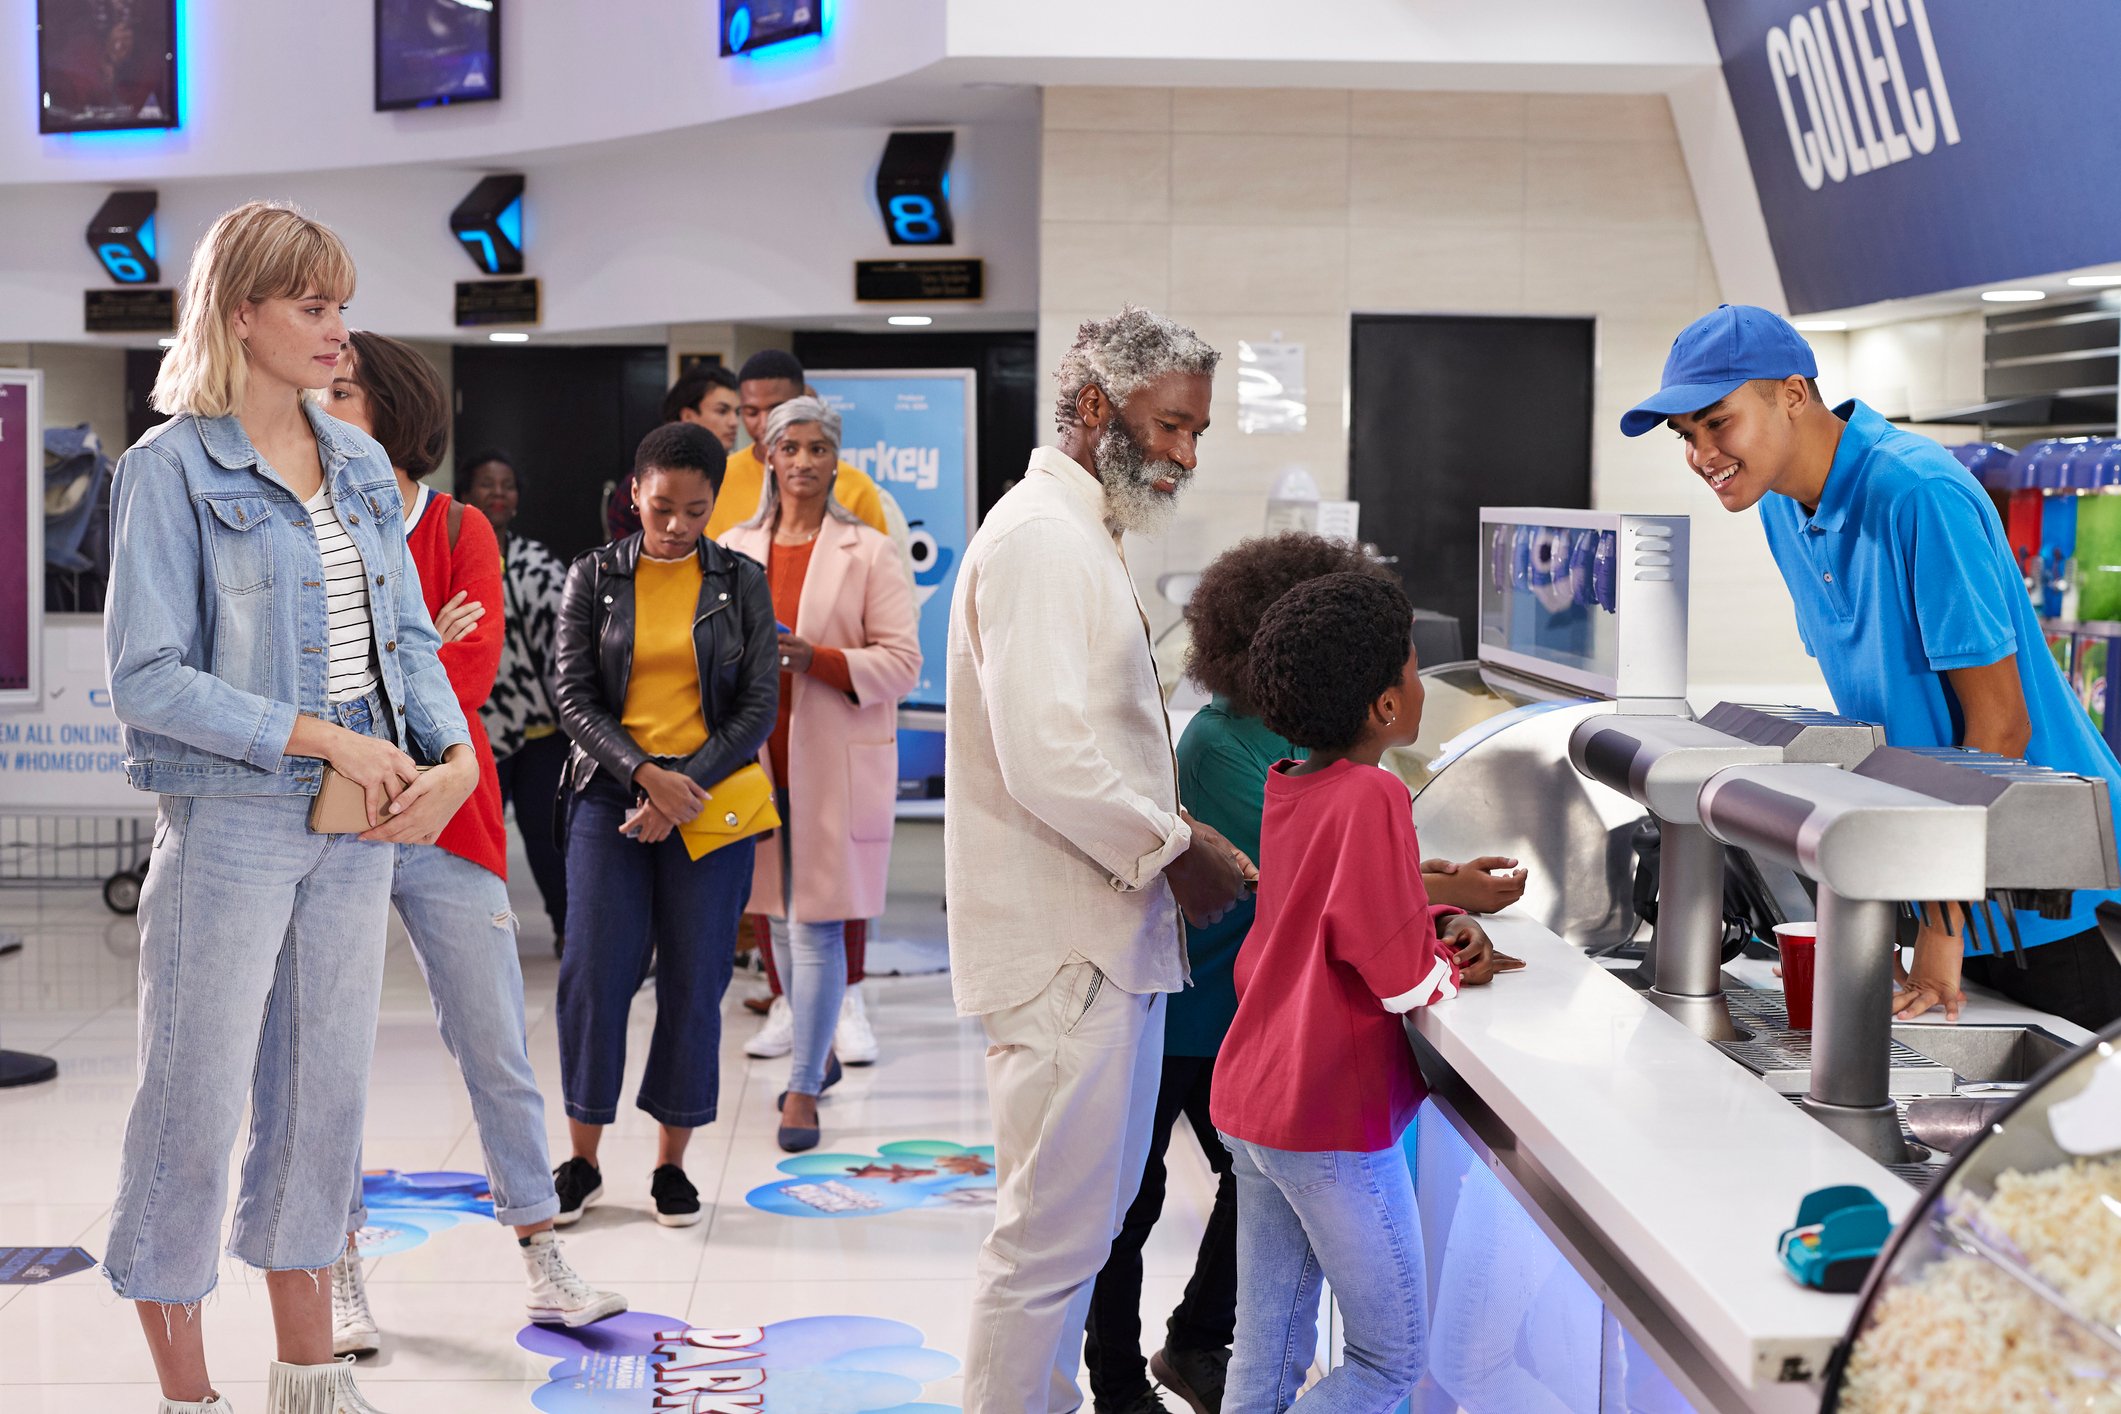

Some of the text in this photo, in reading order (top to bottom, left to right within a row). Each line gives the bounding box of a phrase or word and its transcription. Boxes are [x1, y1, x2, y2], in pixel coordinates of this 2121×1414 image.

[1766, 0, 1961, 191] COLLECT
[888, 194, 942, 243] 8
[97, 242, 147, 283] 6
[458, 230, 500, 273] 7
[25, 723, 53, 745] ALL
[60, 722, 119, 746] ONLINE
